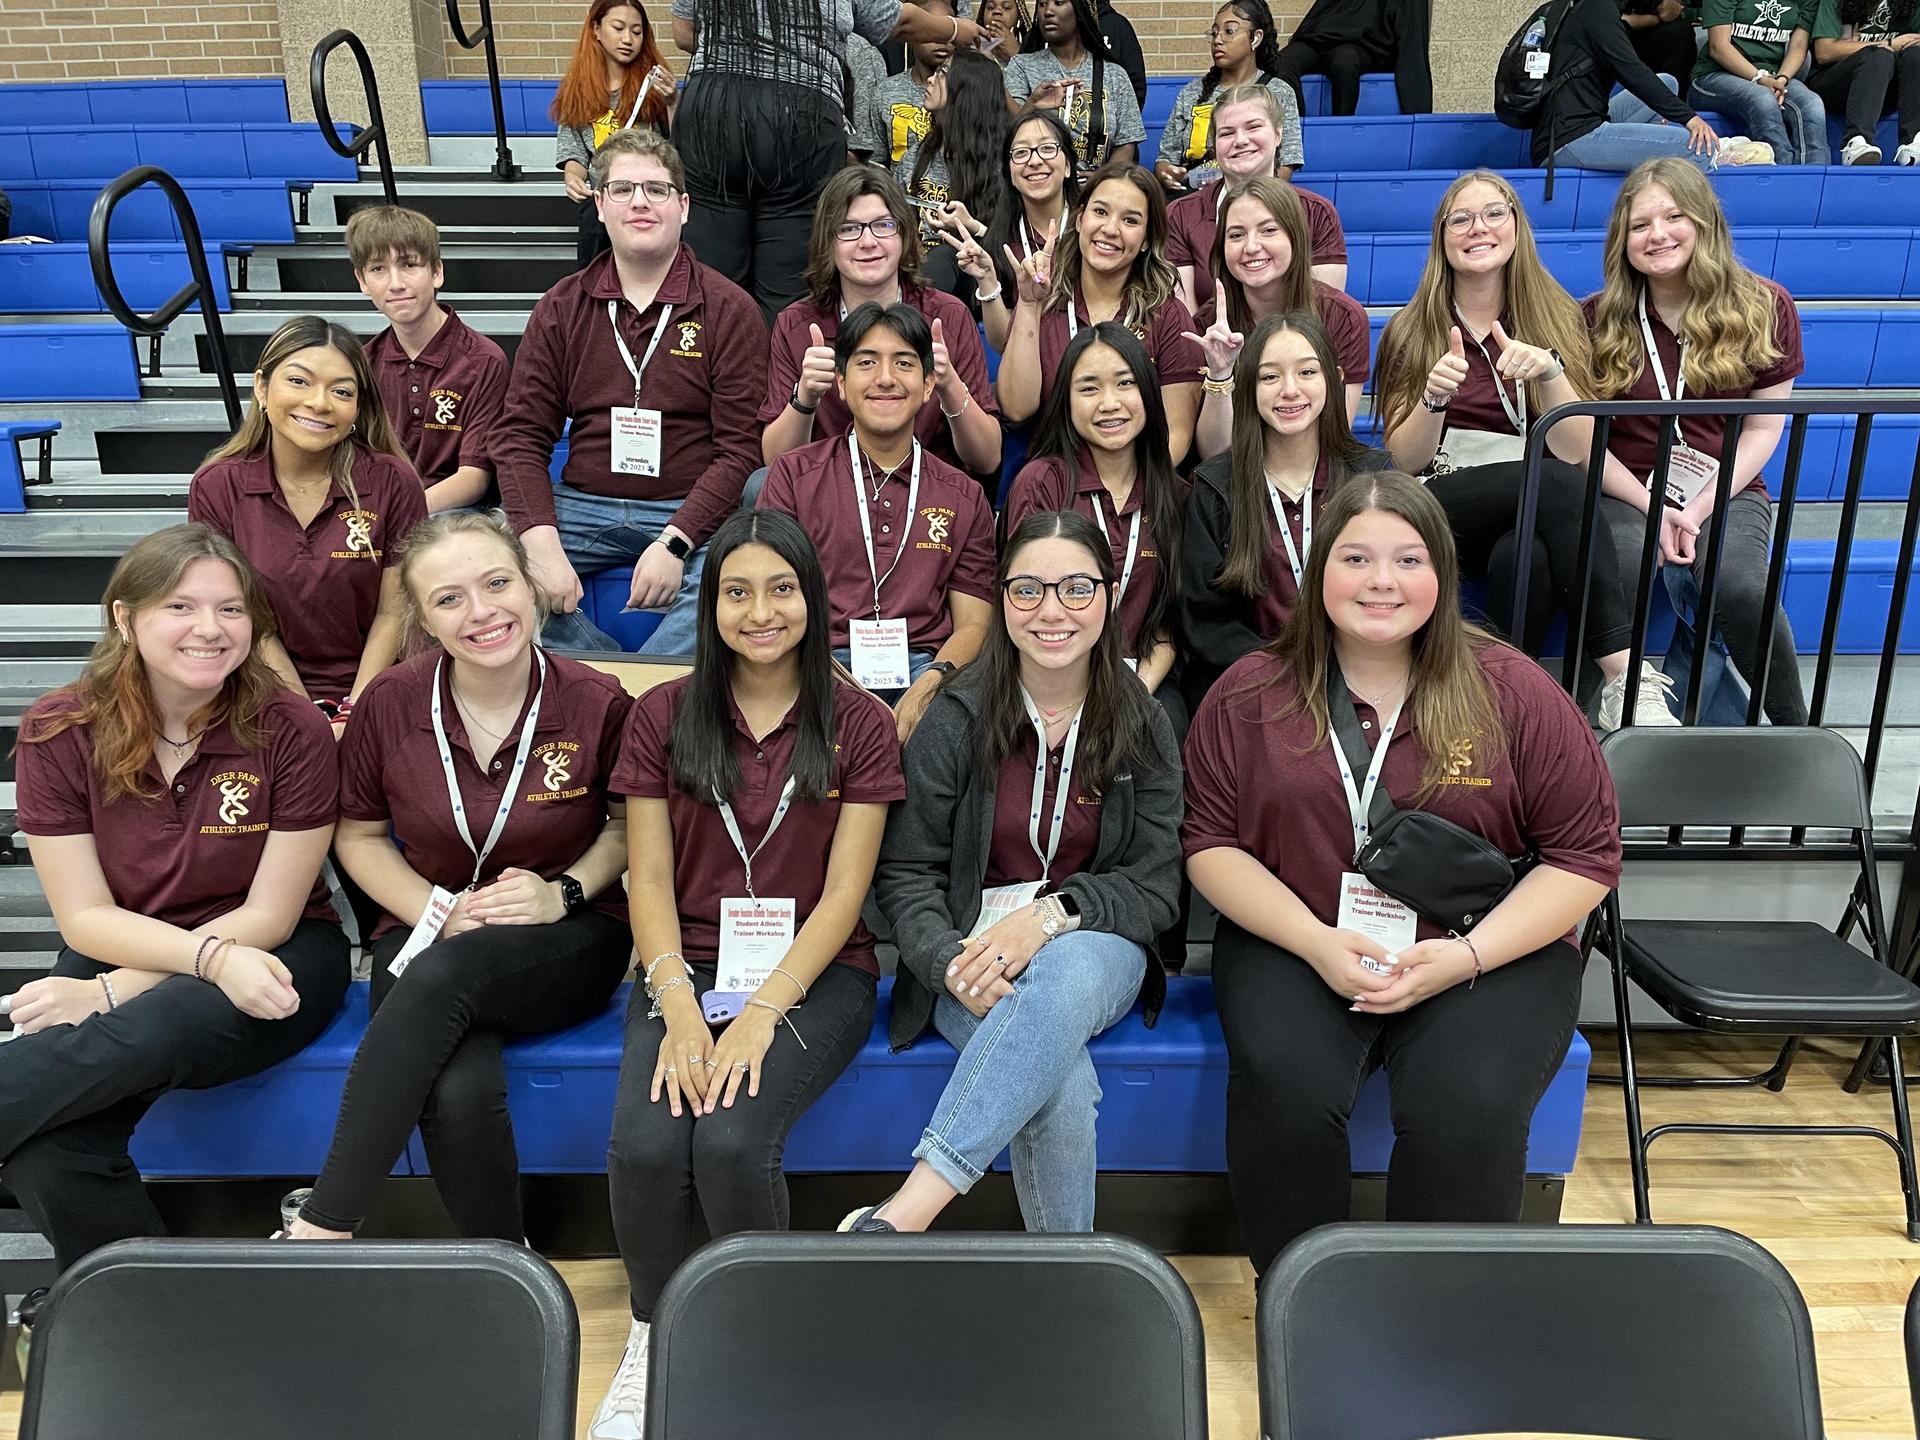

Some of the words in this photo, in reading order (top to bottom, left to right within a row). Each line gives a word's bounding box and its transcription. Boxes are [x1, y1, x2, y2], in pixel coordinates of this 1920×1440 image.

[532, 742, 556, 758] DEER
[557, 741, 580, 752] PARK
[209, 771, 236, 786] DEER
[237, 771, 260, 786] PARK
[1460, 777, 1492, 786] TRAINER
[526, 791, 560, 802] ATHLETIC
[561, 786, 589, 799] TRAINER
[200, 825, 237, 834] ATHLETIC
[237, 823, 270, 833] TRAINER
[1354, 897, 1379, 907] Student
[1380, 900, 1406, 911] Athletic
[1351, 907, 1374, 916] Trainer
[1375, 910, 1407, 921] Workshop
[756, 930, 786, 938] Workshop
[1363, 960, 1380, 972] 202
